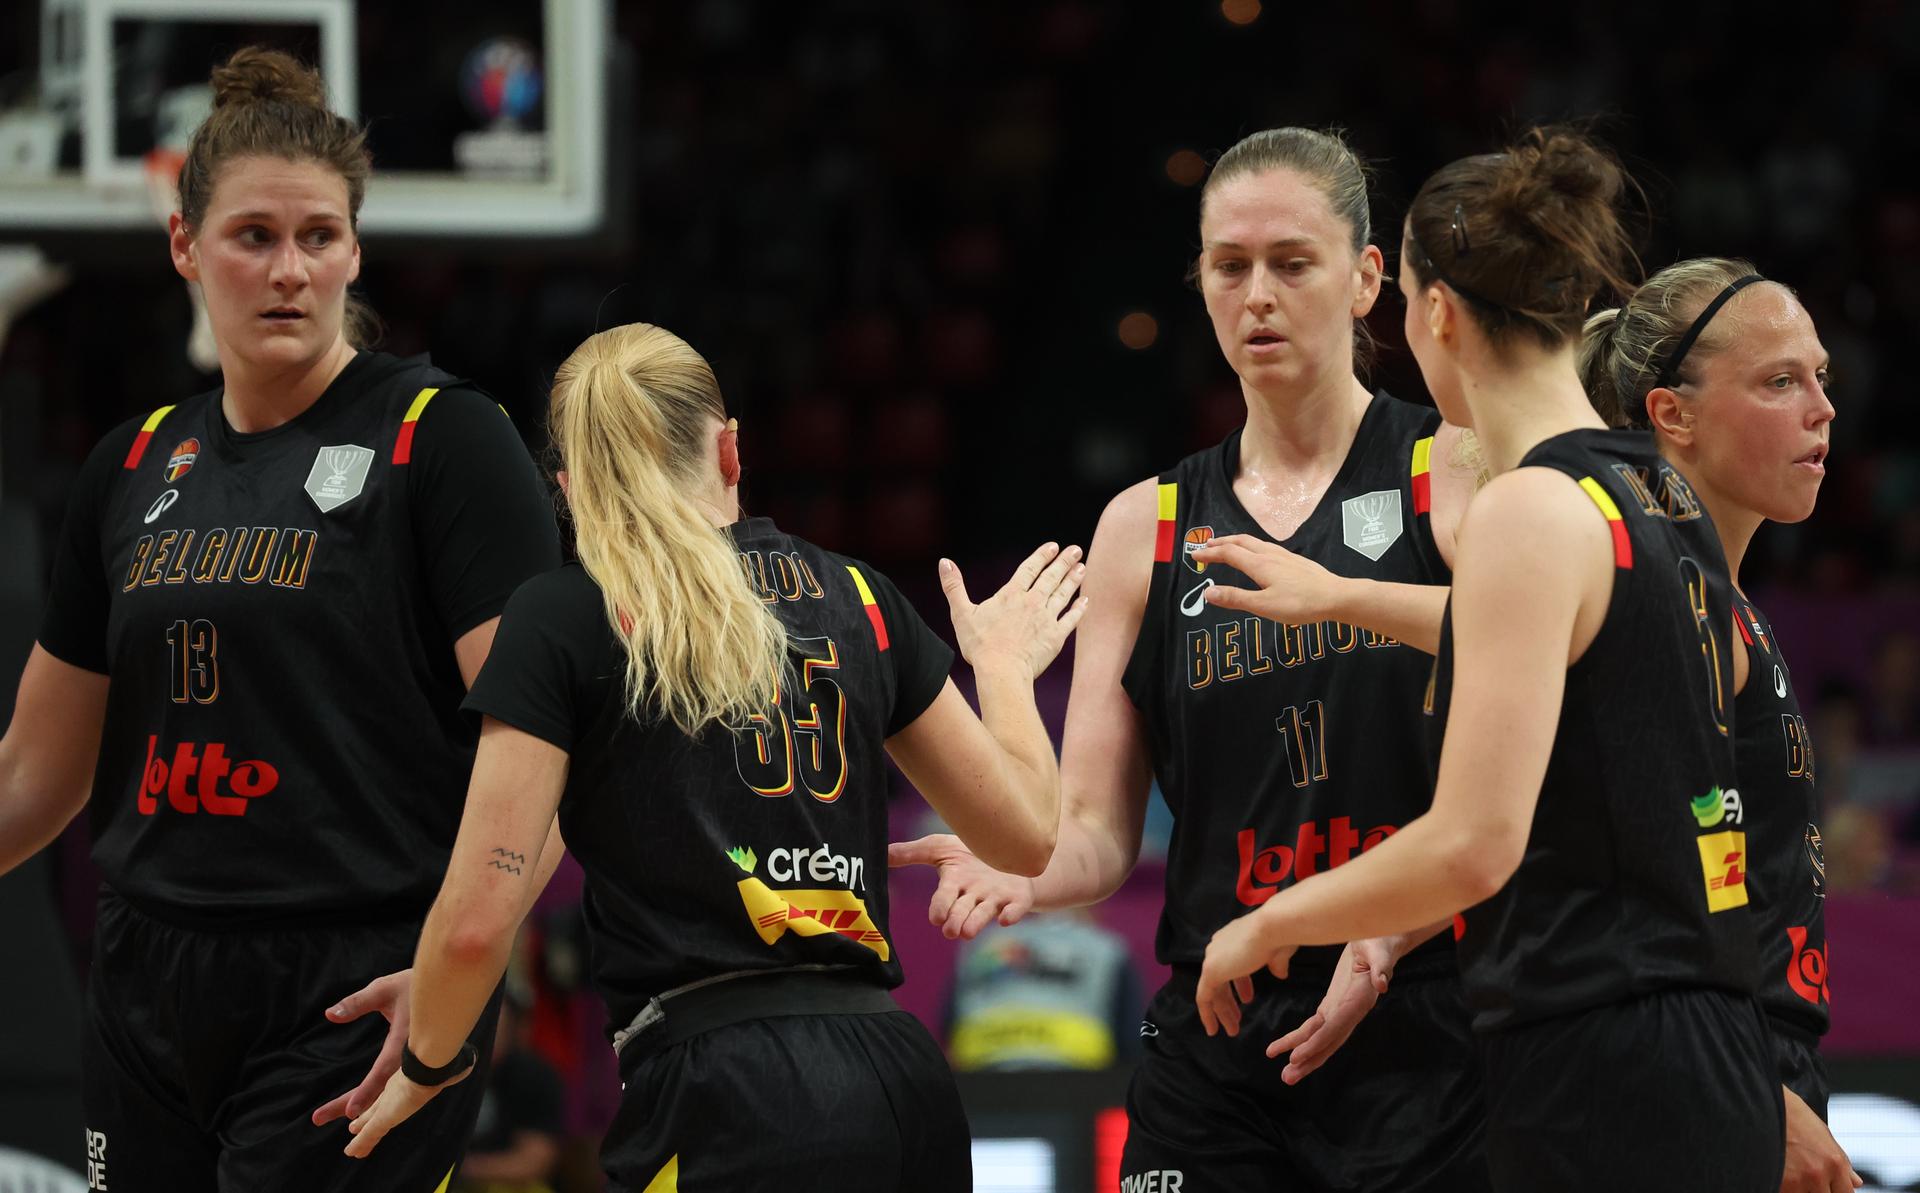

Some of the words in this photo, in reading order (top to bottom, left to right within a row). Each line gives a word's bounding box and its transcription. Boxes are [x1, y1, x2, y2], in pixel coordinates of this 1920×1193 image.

[122, 527, 318, 592] BELGIUM
[166, 618, 218, 704] 13
[137, 733, 280, 817] lotto
[1275, 700, 1328, 788] 11
